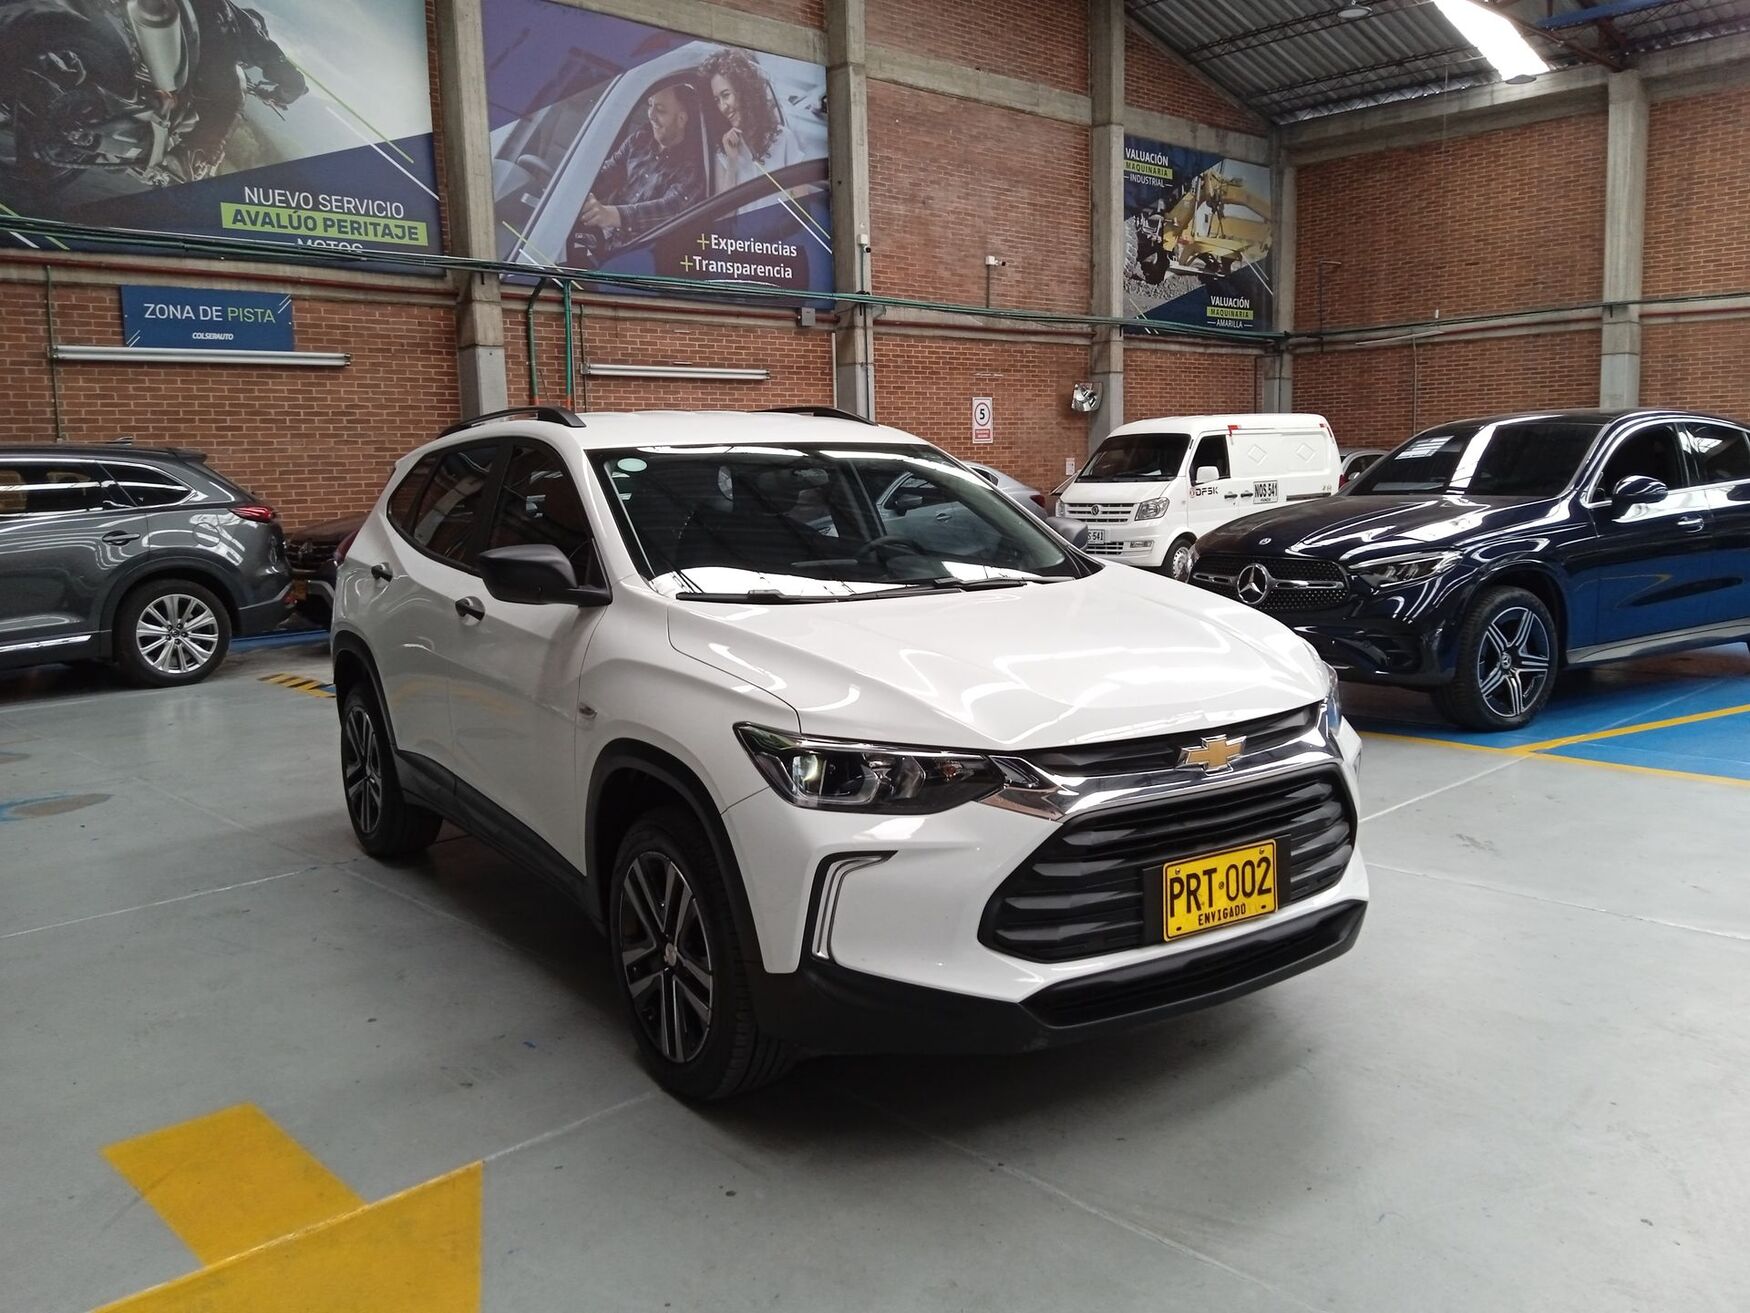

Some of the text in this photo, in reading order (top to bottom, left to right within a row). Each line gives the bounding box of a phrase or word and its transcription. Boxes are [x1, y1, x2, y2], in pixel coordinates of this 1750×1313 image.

[1125, 147, 1169, 167] VALUACIÓN
[1125, 161, 1168, 177] MAQUINARIA
[1130, 173, 1165, 188] INDUSTRIAL
[244, 186, 405, 219] NUEVO SERVICIO
[231, 208, 420, 242] AVALÚO PERITAJE
[1210, 295, 1250, 309] VALUACIÓN
[143, 303, 276, 324] ZONA DE PISTA
[1210, 308, 1249, 318] MAQUINARIA
[1216, 319, 1243, 328] AMARILLA
[979, 408, 985, 420] 5
[1195, 486, 1219, 496] DFSK
[1197, 903, 1247, 926] ENVIGADO
